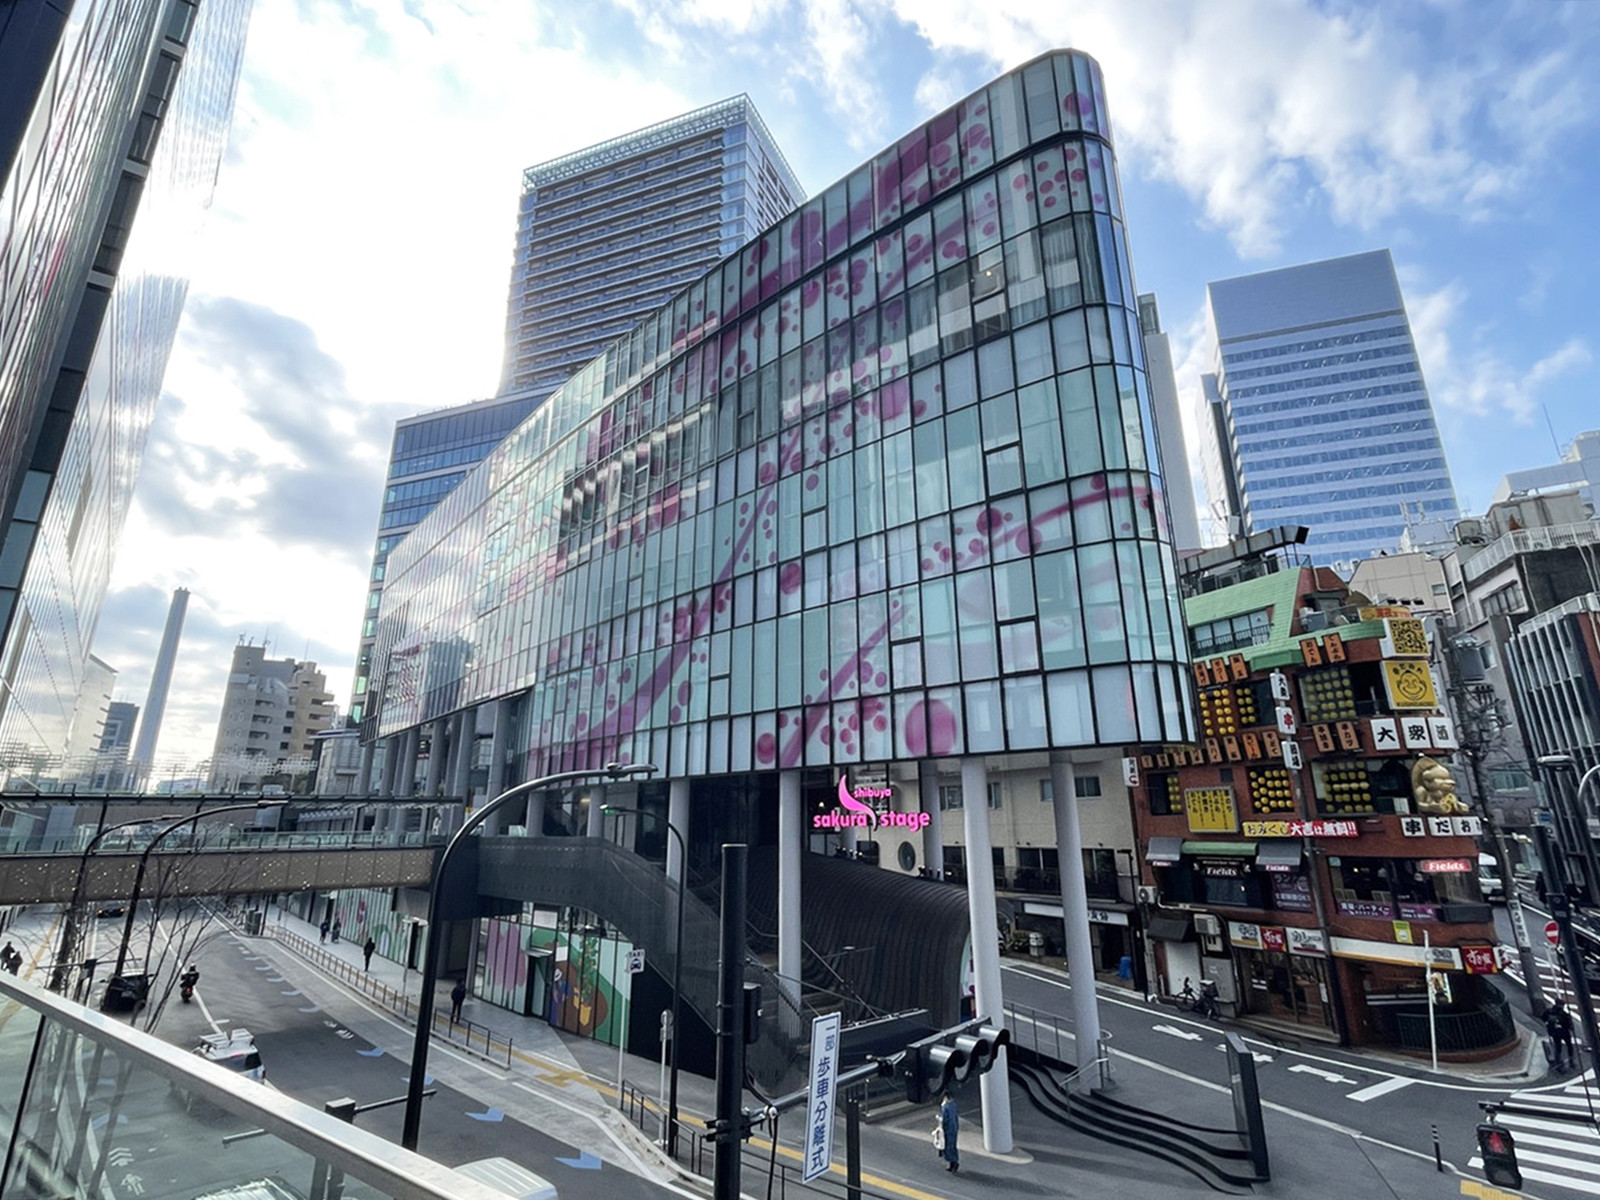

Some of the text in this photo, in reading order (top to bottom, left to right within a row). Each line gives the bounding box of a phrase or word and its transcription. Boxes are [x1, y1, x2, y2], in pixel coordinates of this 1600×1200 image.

[1283, 712, 1294, 730] 串
[853, 786, 892, 798] shibuya
[813, 810, 931, 832] sakura stage
[1206, 866, 1237, 876] Fields
[1428, 861, 1465, 871] Fields
[1466, 949, 1492, 965] すき家
